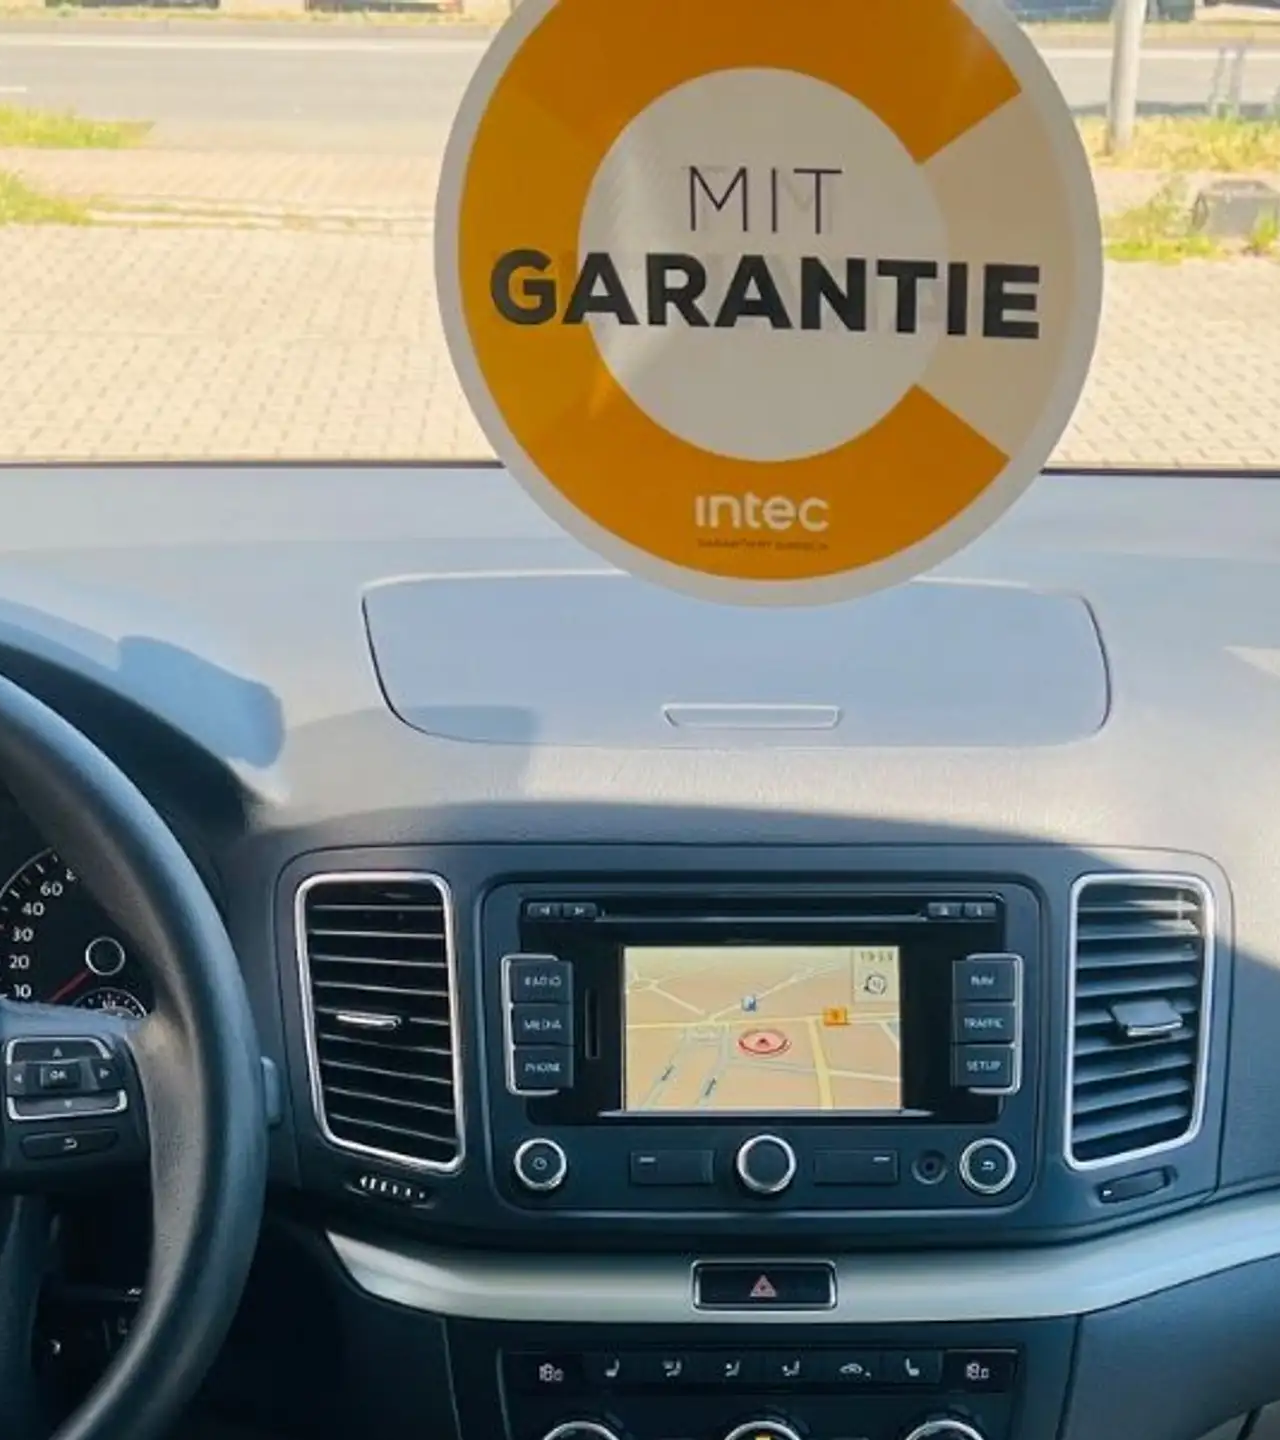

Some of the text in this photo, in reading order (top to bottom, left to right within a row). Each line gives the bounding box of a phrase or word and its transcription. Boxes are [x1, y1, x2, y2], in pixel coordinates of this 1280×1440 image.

[688, 165, 843, 234] MIT
[489, 248, 1040, 340] GARANTIE
[694, 491, 830, 532] intec
[40, 881, 63, 896] 60
[22, 902, 45, 916] 40
[12, 927, 34, 942] 30
[9, 955, 30, 969] 20
[14, 984, 32, 999] 10
[966, 1060, 1001, 1073] SETUP
